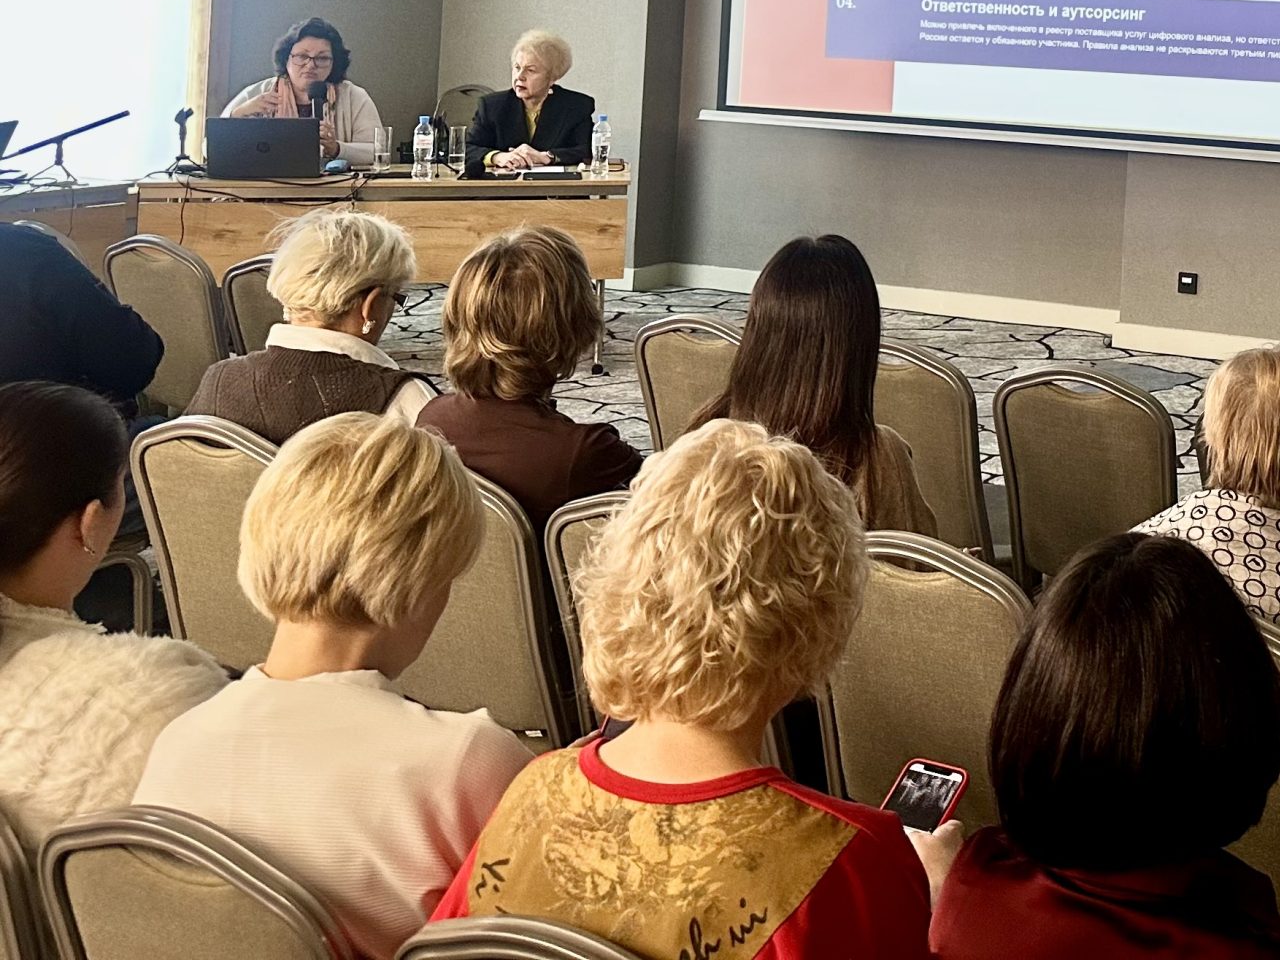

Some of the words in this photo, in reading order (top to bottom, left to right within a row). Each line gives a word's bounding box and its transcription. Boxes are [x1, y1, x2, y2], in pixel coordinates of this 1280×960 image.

[1048, 5, 1057, 17] и
[1061, 5, 1145, 25] аутсорсинг
[948, 33, 984, 44] остается
[984, 35, 990, 46] у
[1119, 42, 1154, 53] анализа
[1155, 44, 1166, 53] не
[1037, 25, 1043, 34] в
[1044, 26, 1073, 38] реестр
[1124, 30, 1146, 41] услуг
[1148, 29, 1194, 44] цифрового
[1234, 35, 1246, 44] но
